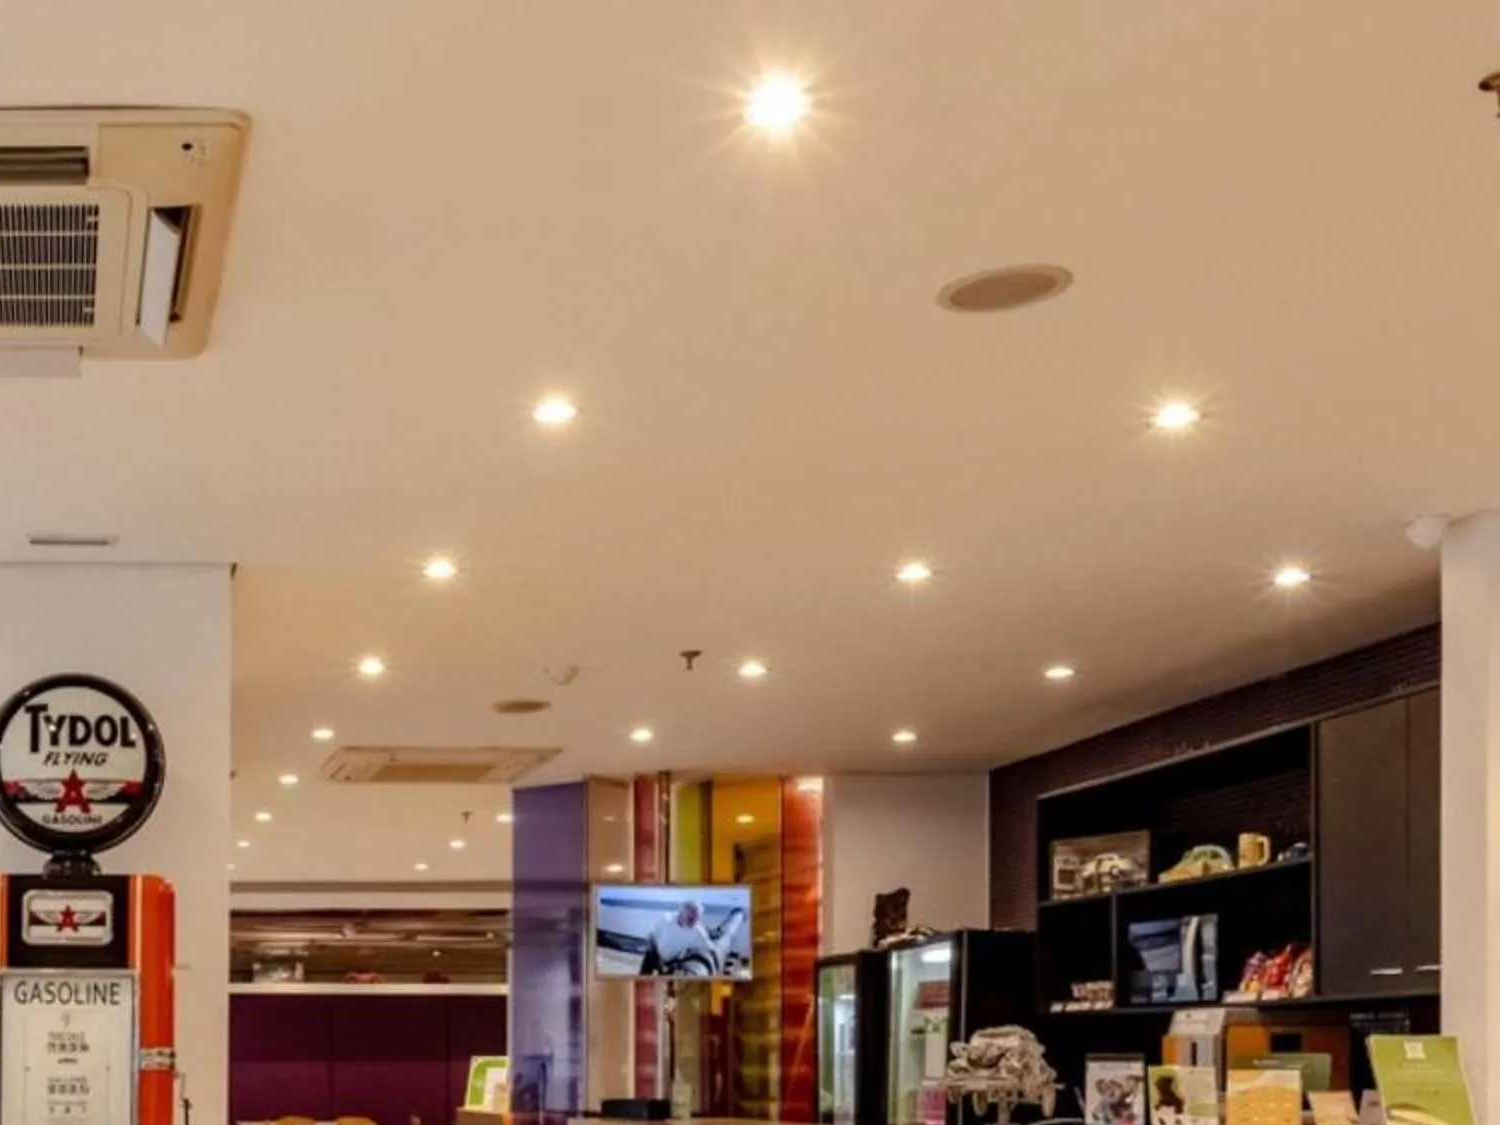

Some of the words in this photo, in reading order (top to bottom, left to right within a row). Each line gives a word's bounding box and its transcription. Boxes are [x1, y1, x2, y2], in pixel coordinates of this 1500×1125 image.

[23, 702, 137, 754] TYDOL
[43, 751, 109, 767] FLYING
[13, 980, 122, 1007] GASOLINE
